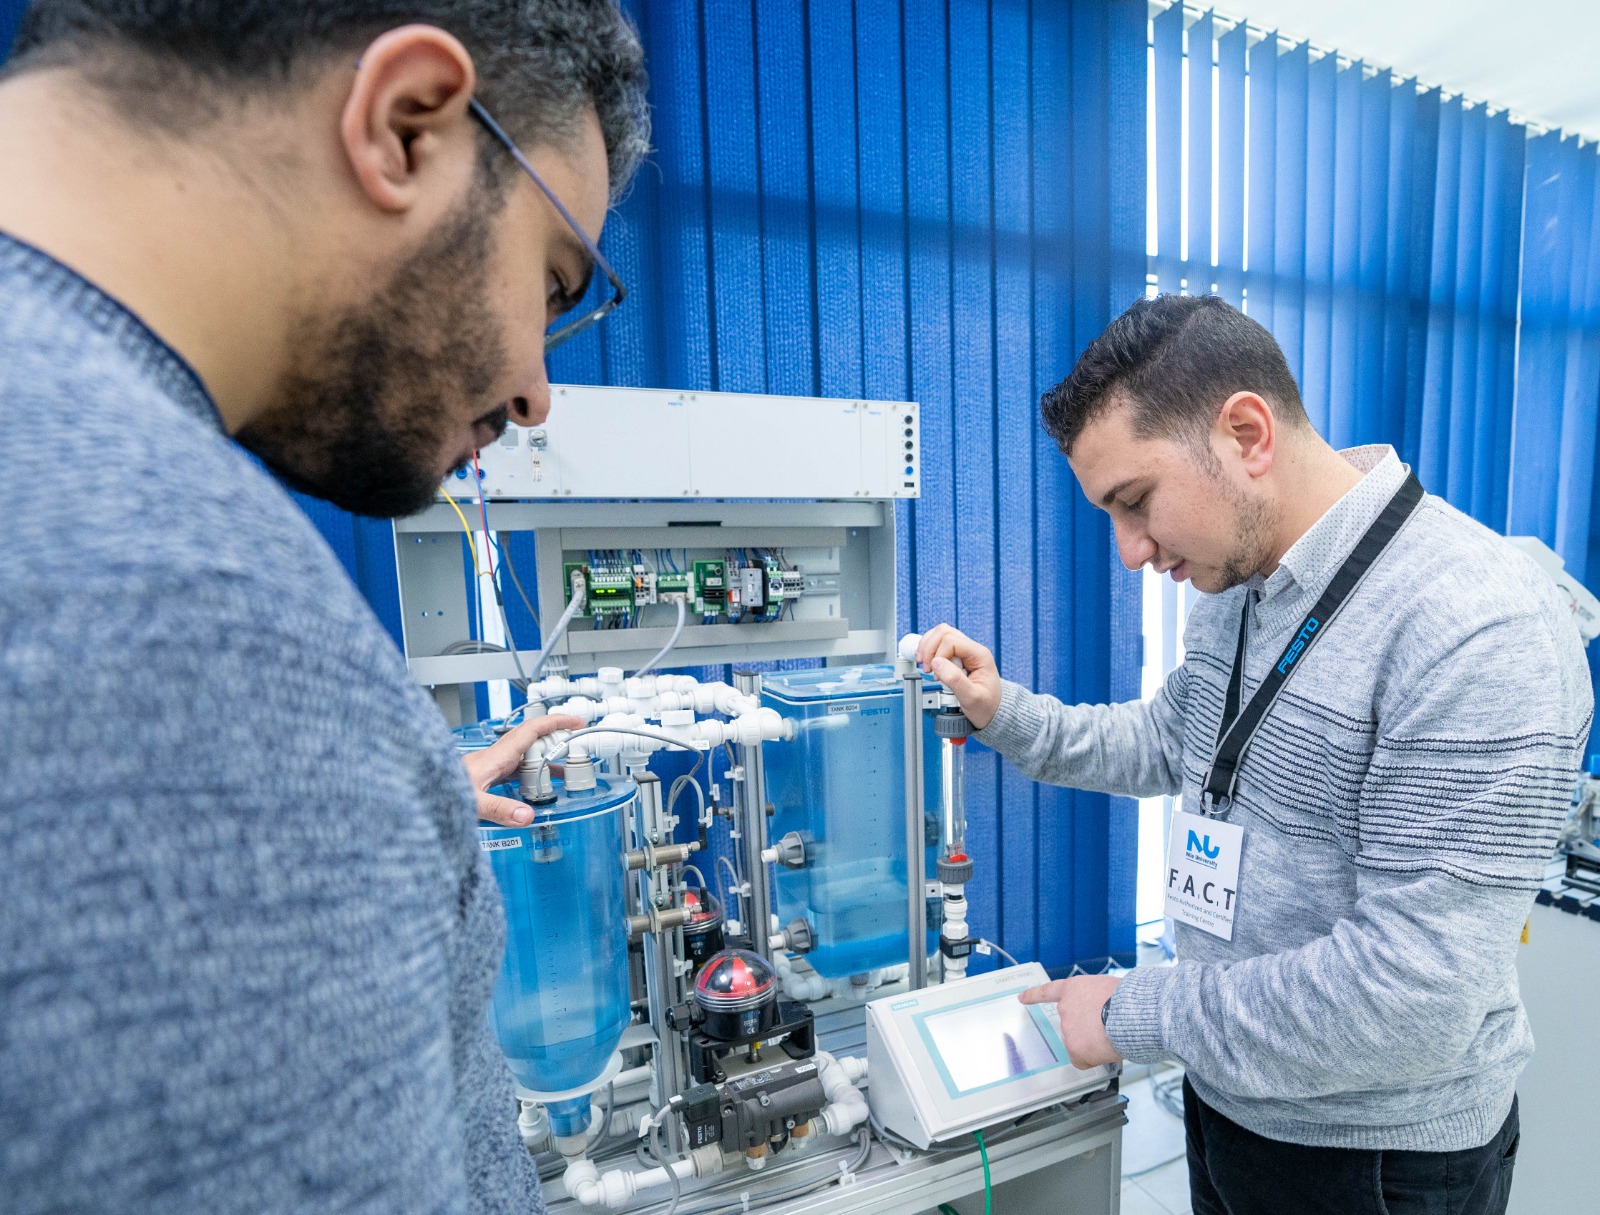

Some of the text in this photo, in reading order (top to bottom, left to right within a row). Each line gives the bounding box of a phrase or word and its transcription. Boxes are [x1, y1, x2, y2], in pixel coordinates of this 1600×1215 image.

[1277, 617, 1319, 675] FESTO
[860, 707, 890, 716] FESTO
[481, 839, 519, 849] TANK B201
[525, 838, 571, 851] FESTO
[1186, 829, 1220, 859] NU
[1195, 854, 1218, 868] University
